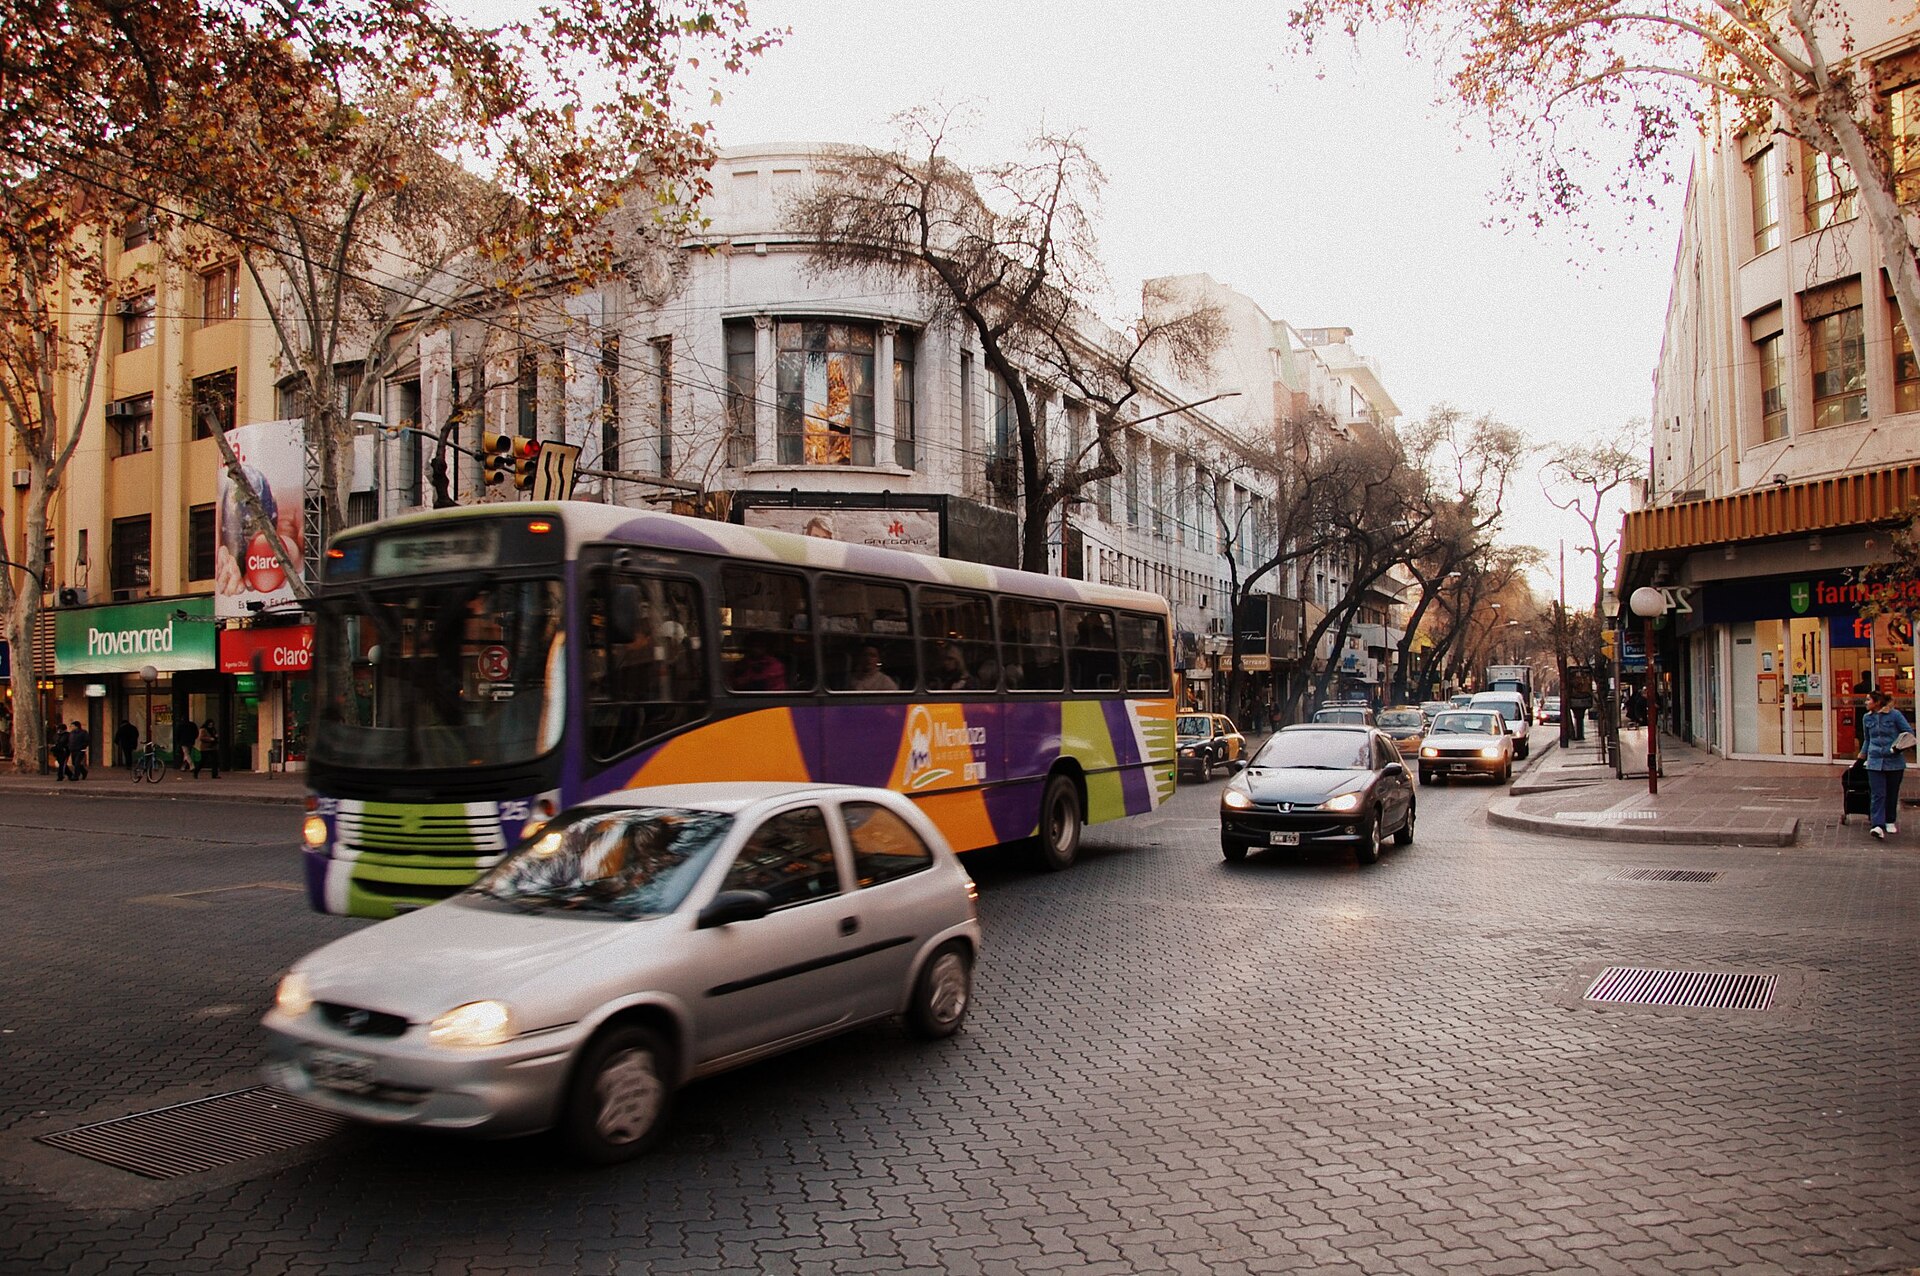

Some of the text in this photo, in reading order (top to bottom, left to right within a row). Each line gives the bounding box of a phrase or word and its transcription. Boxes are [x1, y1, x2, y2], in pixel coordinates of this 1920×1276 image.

[248, 556, 280, 571] Claro
[88, 620, 173, 656] Provencred
[273, 647, 308, 665] Claro
[934, 722, 986, 748] Mendoza
[501, 801, 529, 820] 25
